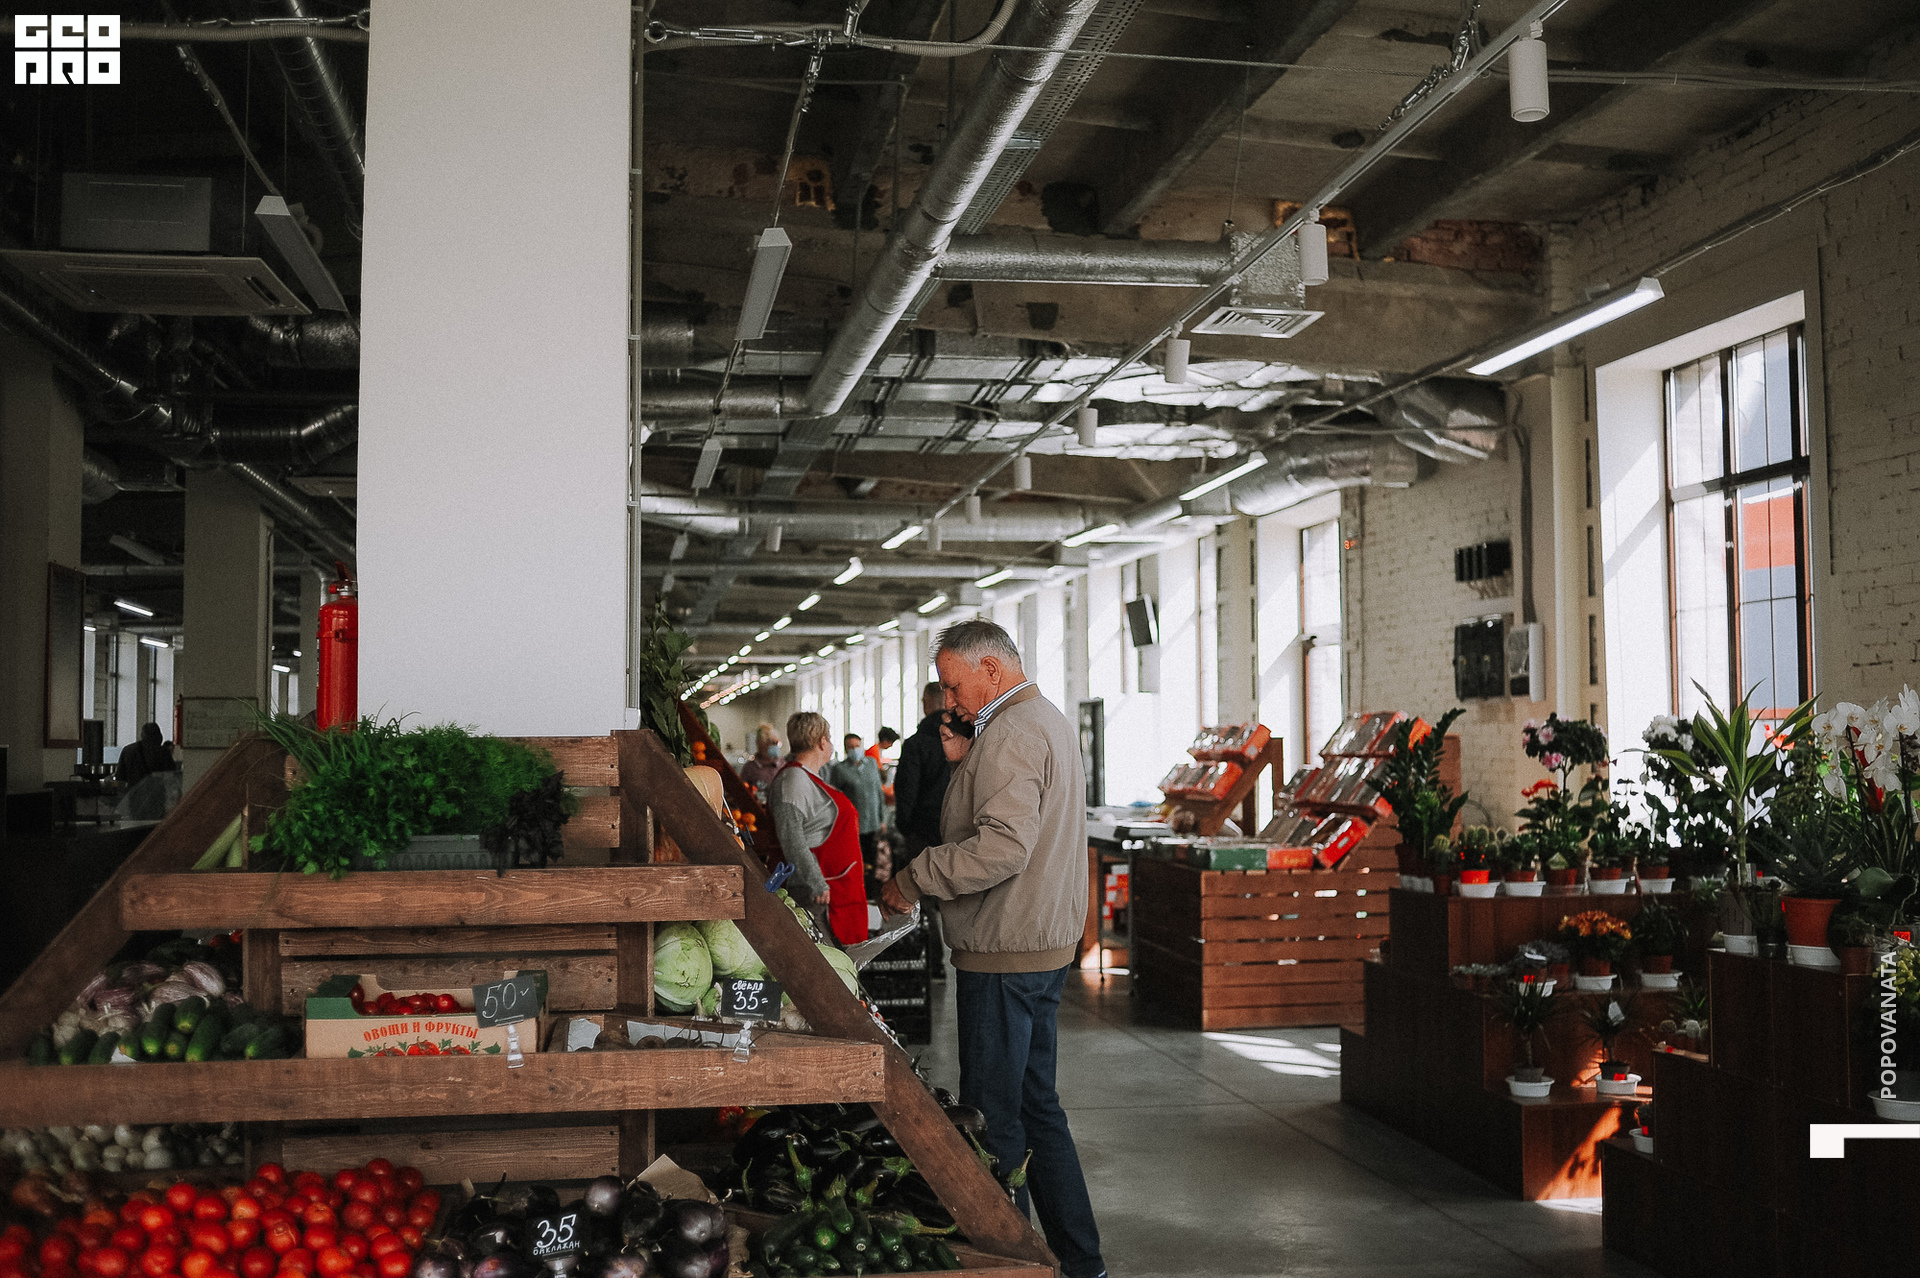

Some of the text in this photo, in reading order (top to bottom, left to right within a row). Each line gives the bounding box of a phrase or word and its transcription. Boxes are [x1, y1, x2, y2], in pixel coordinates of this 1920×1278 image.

[363, 1021, 479, 1042] ОВОЩИ И ФРУКТЫ
[536, 1214, 577, 1248] 35
